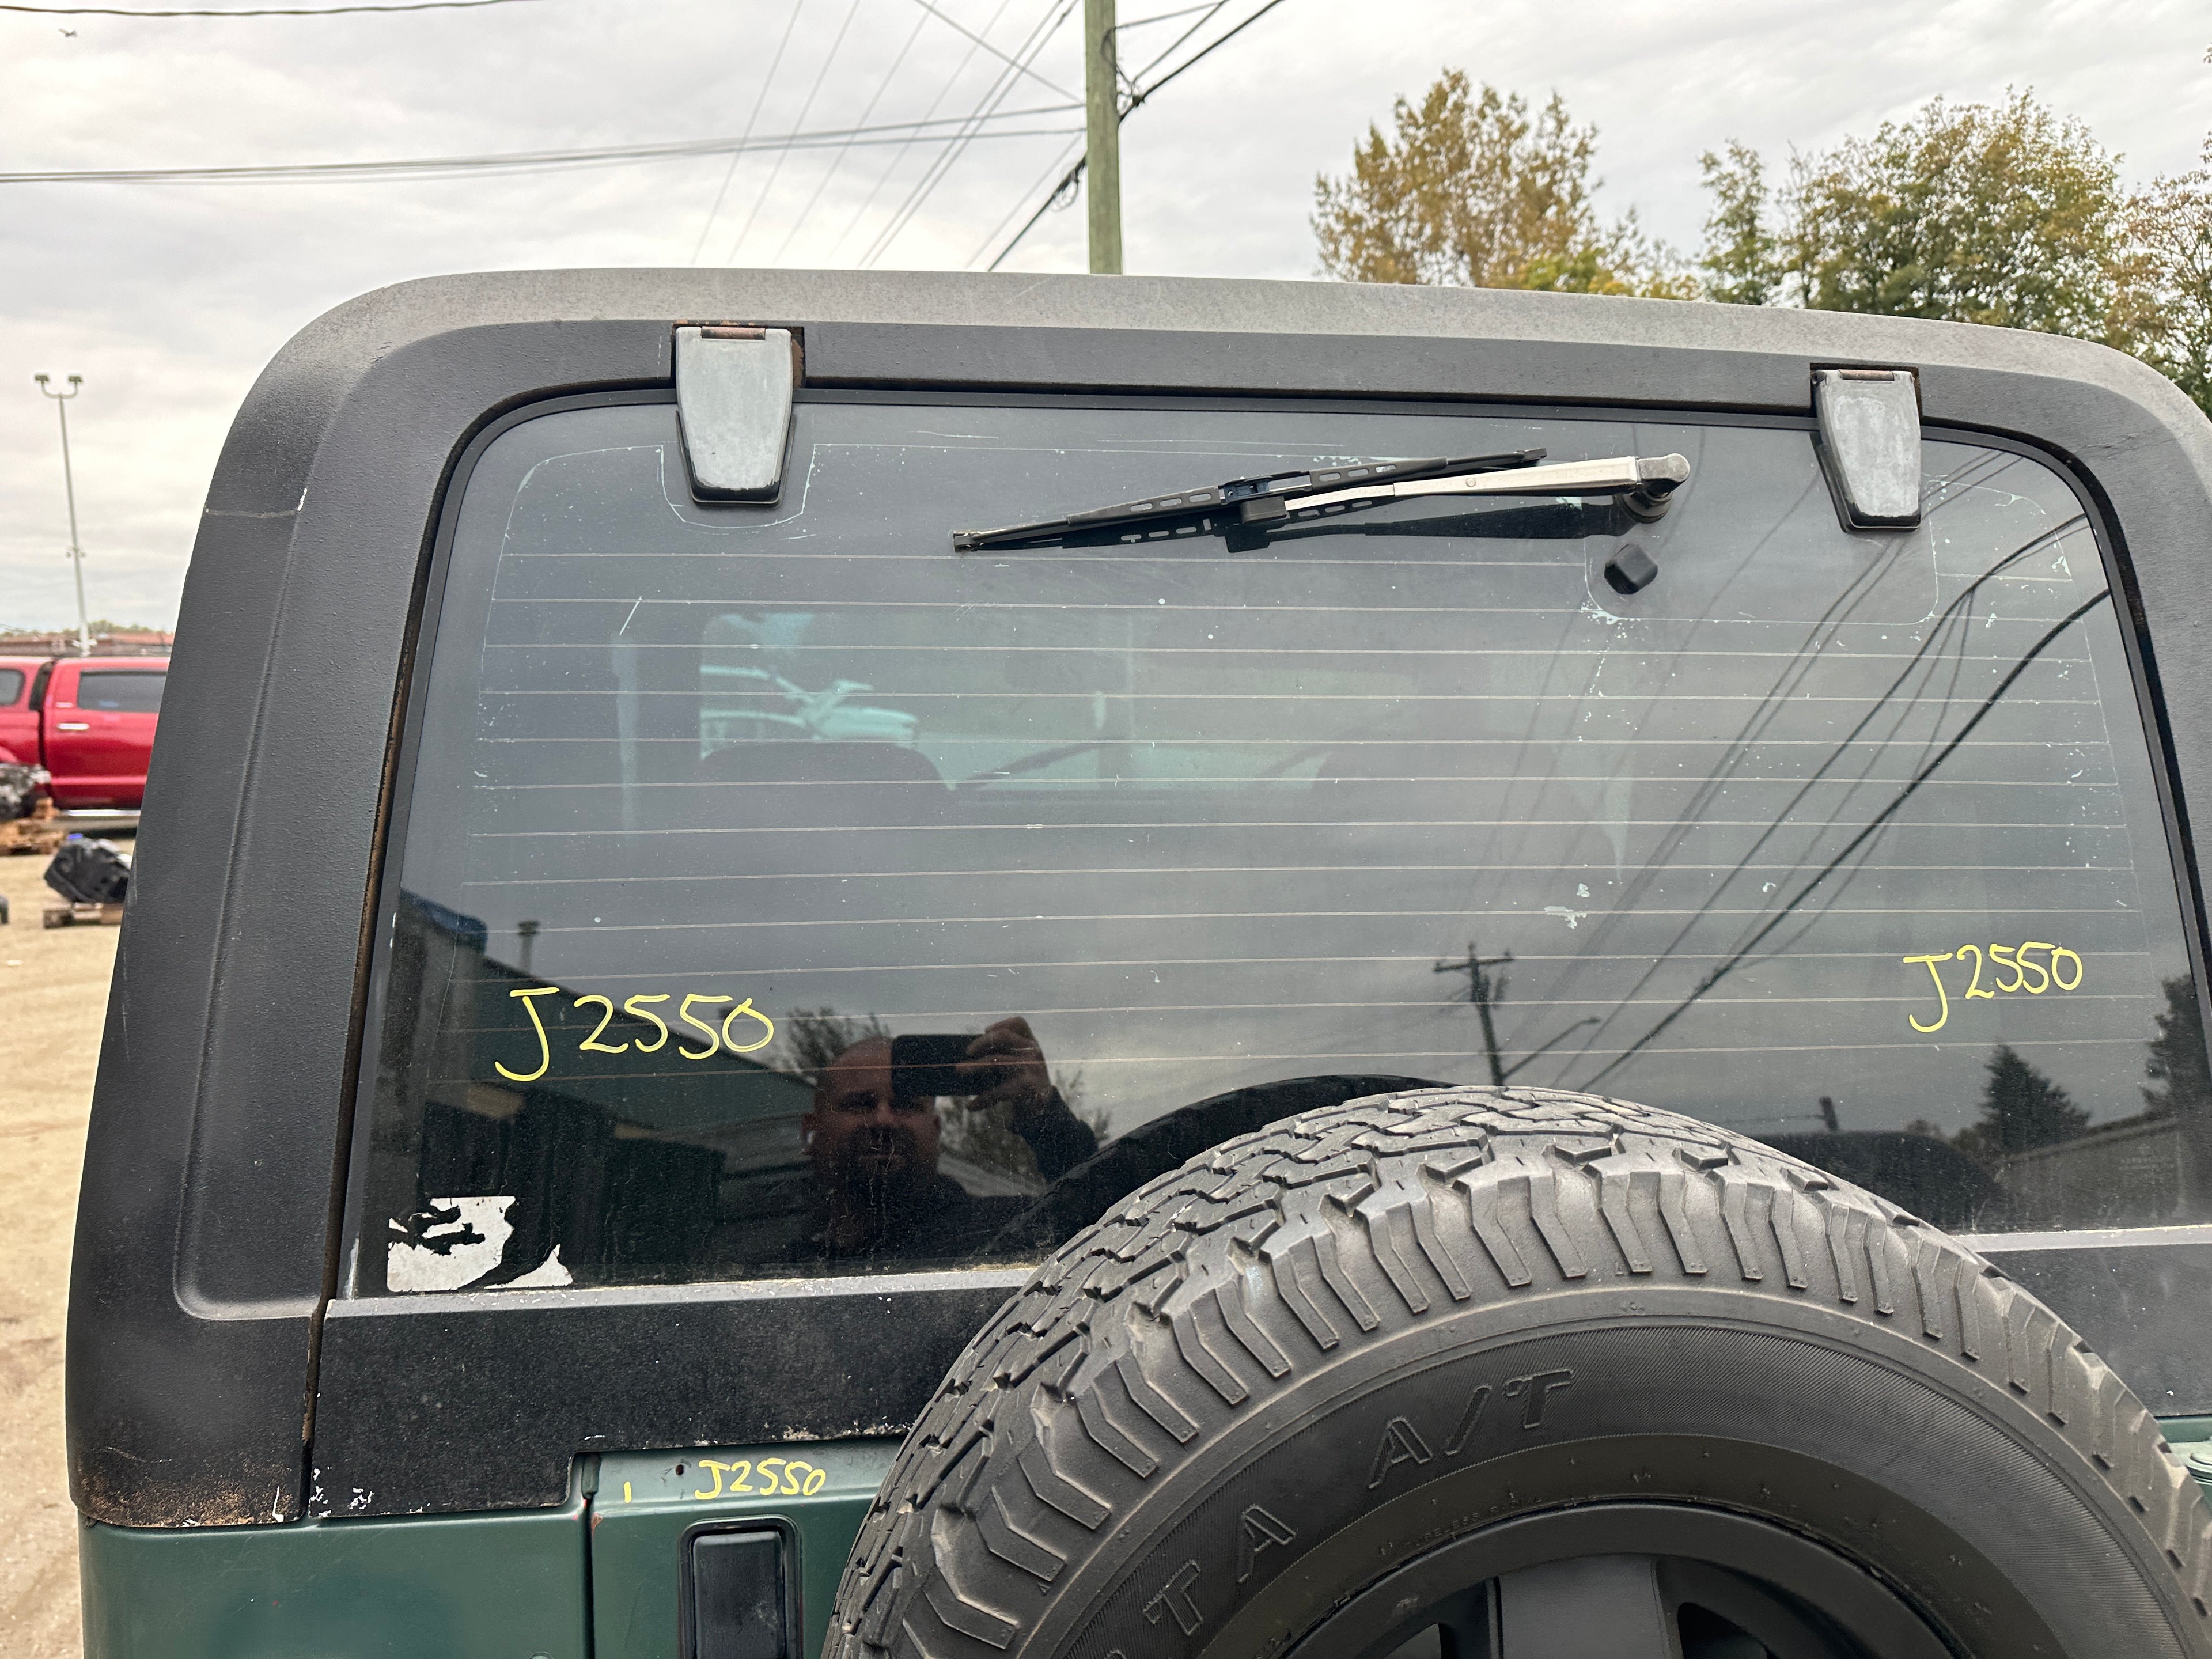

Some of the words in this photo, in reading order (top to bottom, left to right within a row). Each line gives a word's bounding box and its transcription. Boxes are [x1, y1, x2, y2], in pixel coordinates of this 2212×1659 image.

[1903, 941, 2083, 1033] J2550
[494, 987, 774, 1081] J2550
[695, 1457, 826, 1500] J2550
[1104, 1503, 1297, 1659] TA
[1368, 1368, 1574, 1489] A/T
